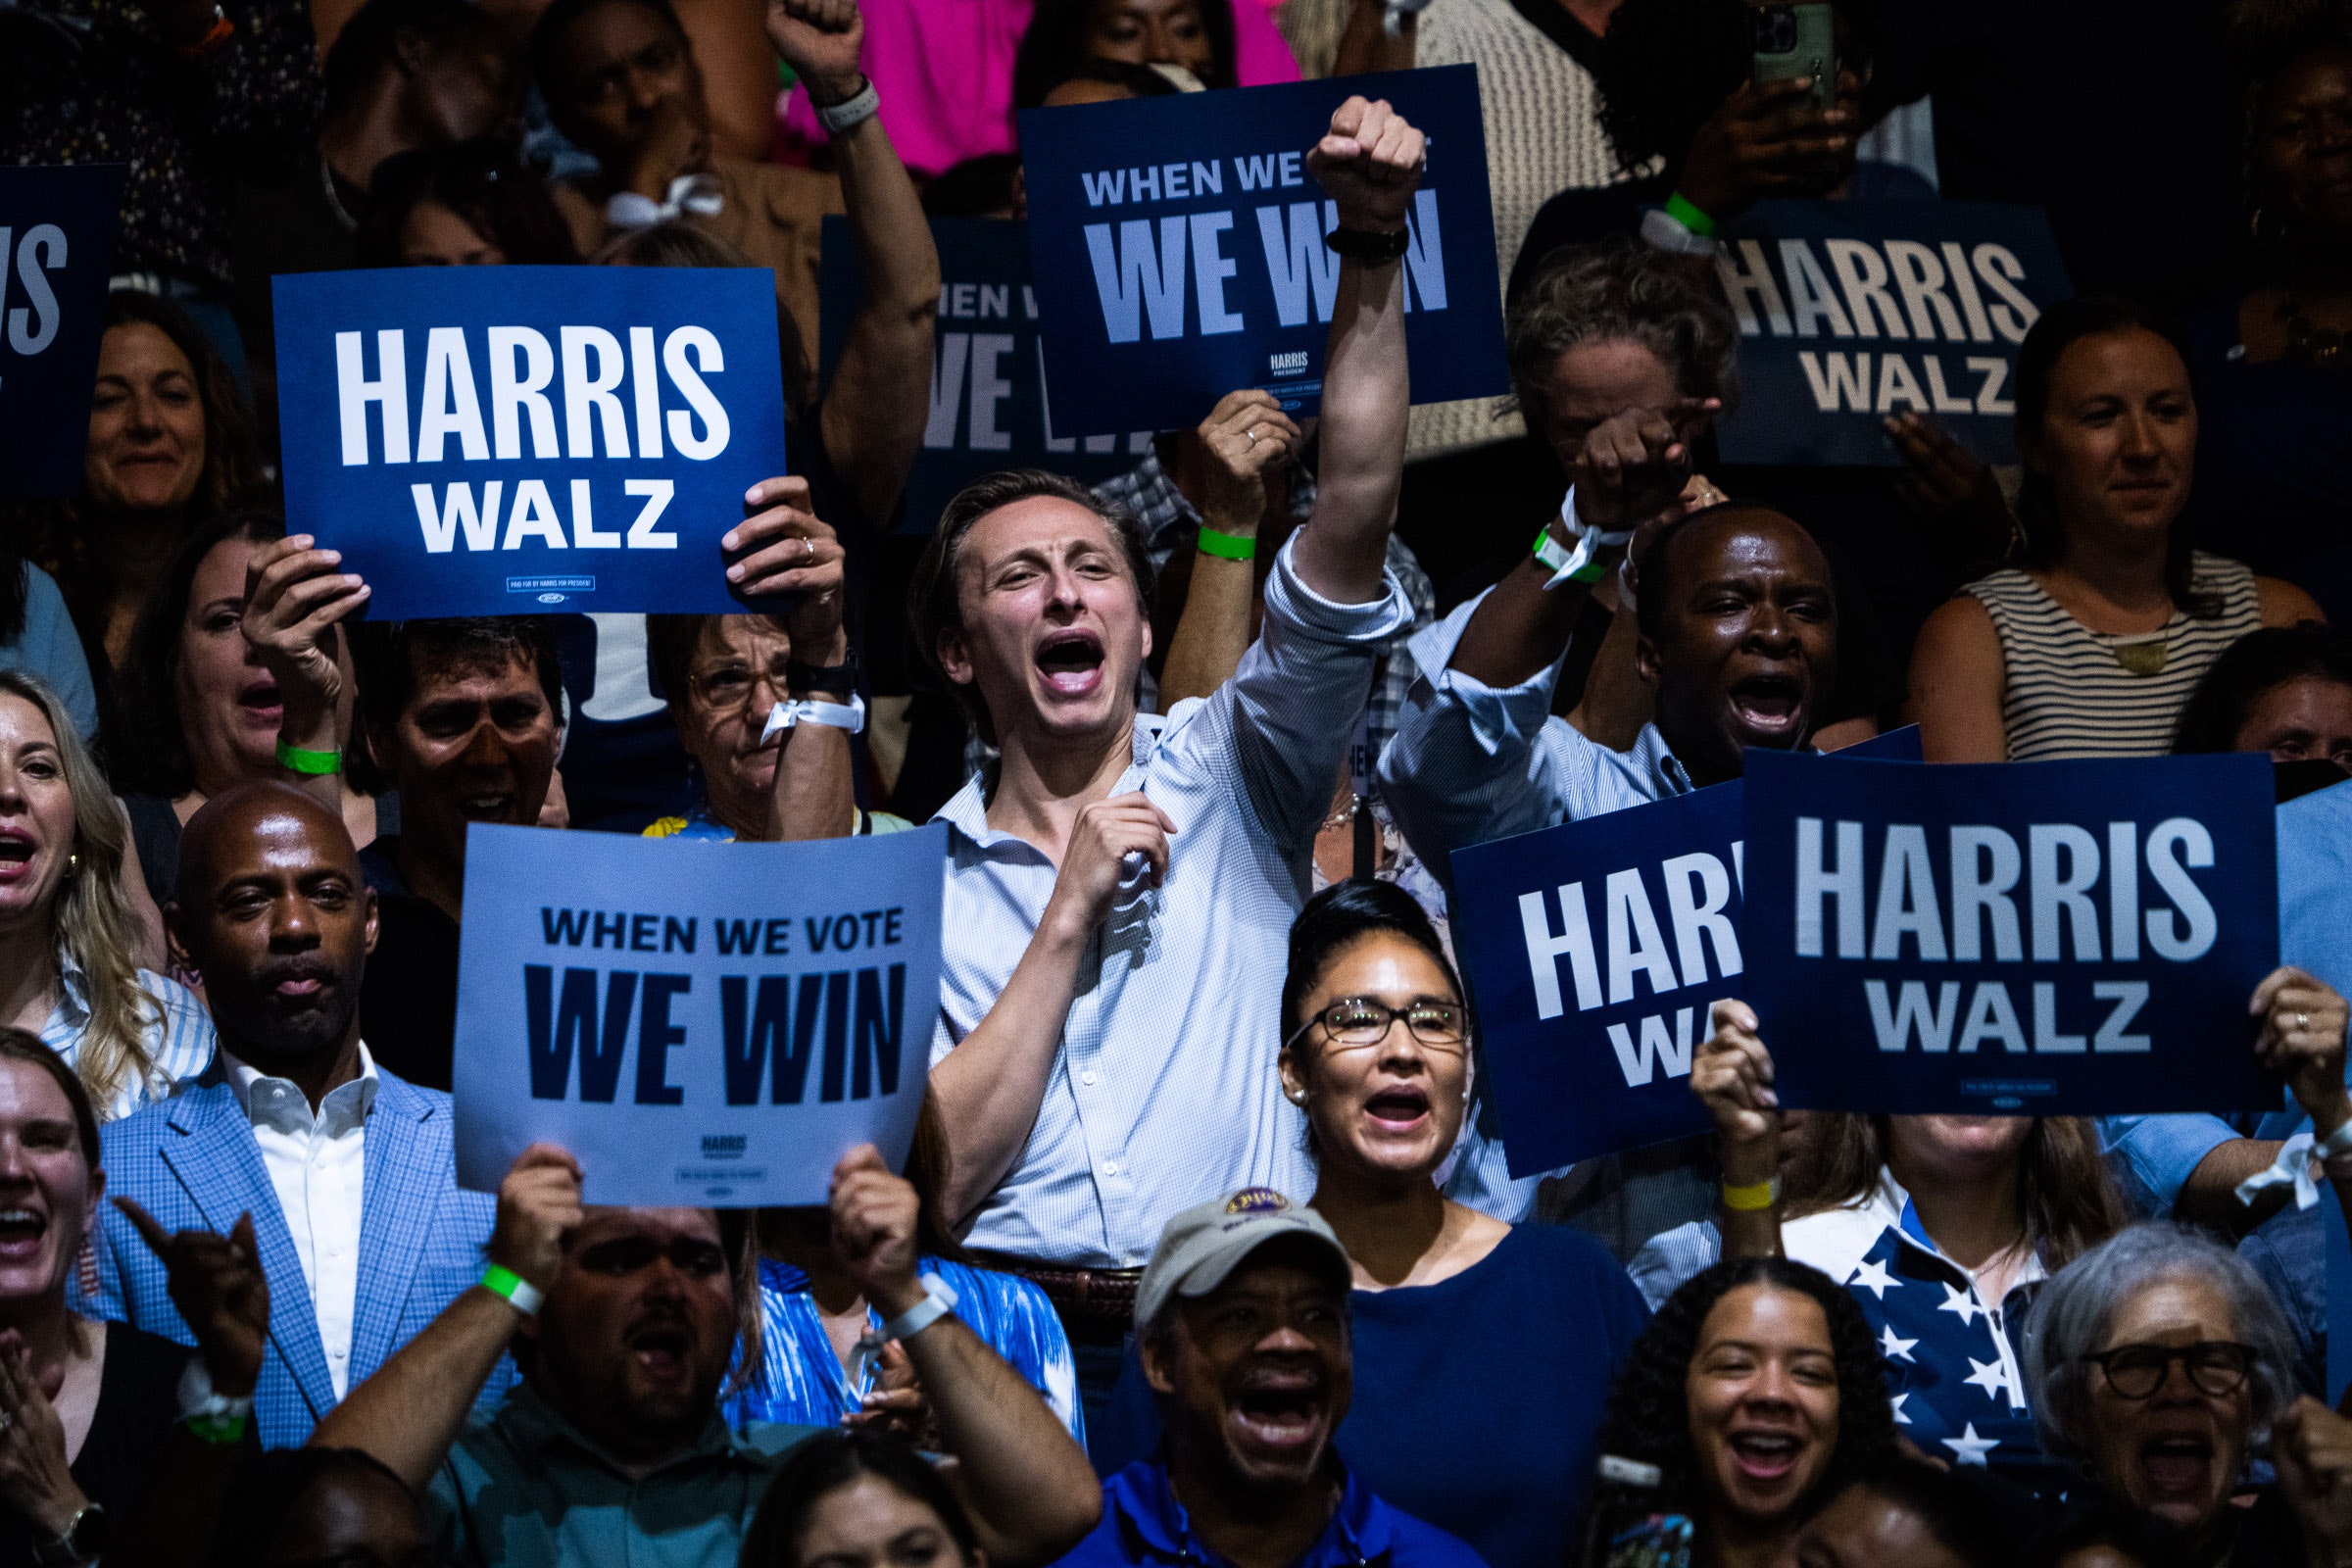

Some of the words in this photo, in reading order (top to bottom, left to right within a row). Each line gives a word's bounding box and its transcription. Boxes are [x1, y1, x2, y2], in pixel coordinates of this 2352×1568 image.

[1082, 159, 1223, 208] WHEN
[1234, 151, 1304, 192] WE
[1083, 210, 1245, 344] WE
[1255, 188, 1447, 327] WN
[1716, 238, 2041, 345] HARRIS
[335, 325, 731, 466] HARRIS
[1270, 351, 1308, 369] HARRIS
[1796, 350, 2019, 416] WALZ
[411, 478, 678, 554] WALZ
[541, 906, 699, 955] WHEN
[714, 917, 793, 956] WE
[805, 906, 904, 953] VOTE
[1518, 840, 1744, 1021] HAR
[1794, 816, 2218, 962] HARRIS
[523, 963, 693, 1106] WE
[719, 961, 907, 1107] WIN
[1863, 978, 2152, 1054] WALZ
